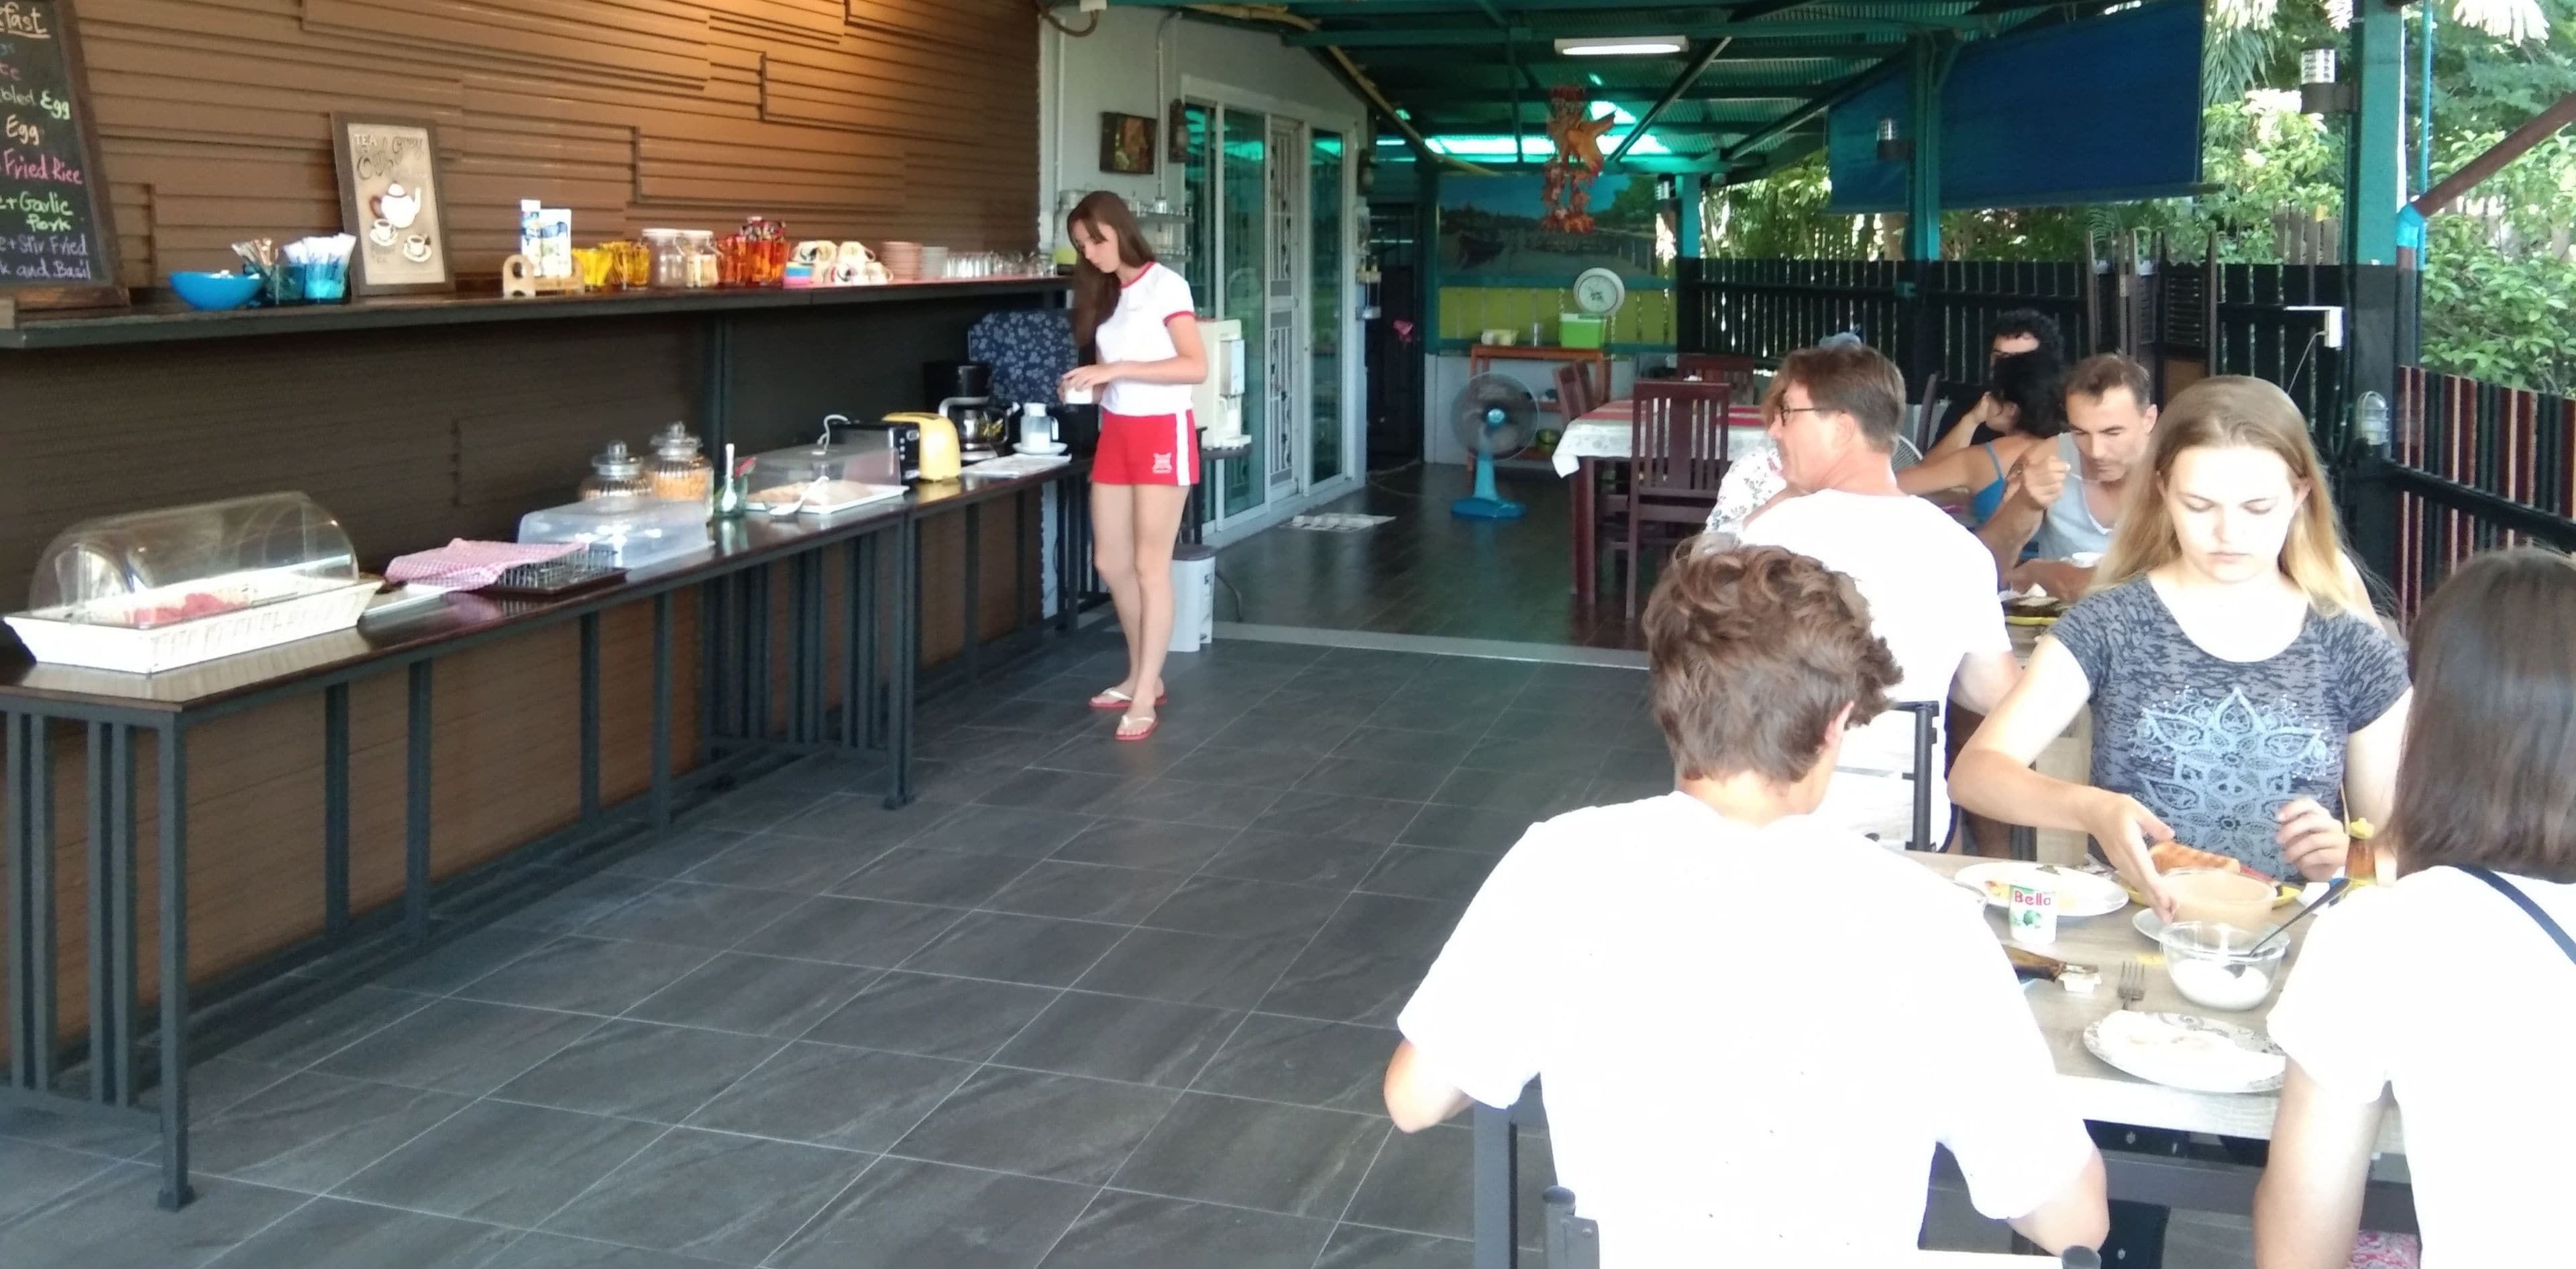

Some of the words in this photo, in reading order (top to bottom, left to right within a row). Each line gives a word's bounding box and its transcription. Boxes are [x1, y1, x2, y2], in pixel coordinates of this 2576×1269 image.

[0, 1, 48, 34] fast
[0, 84, 36, 106] bled
[40, 89, 70, 120] Egg
[6, 114, 40, 146] Egg
[354, 134, 377, 146] TEA
[3, 148, 49, 179] Fried
[52, 156, 83, 185] Rice
[26, 213, 72, 232] Pork
[50, 232, 89, 256] Fried
[16, 257, 51, 278] and
[53, 259, 91, 279] Basil
[2015, 890, 2051, 906] Bella
